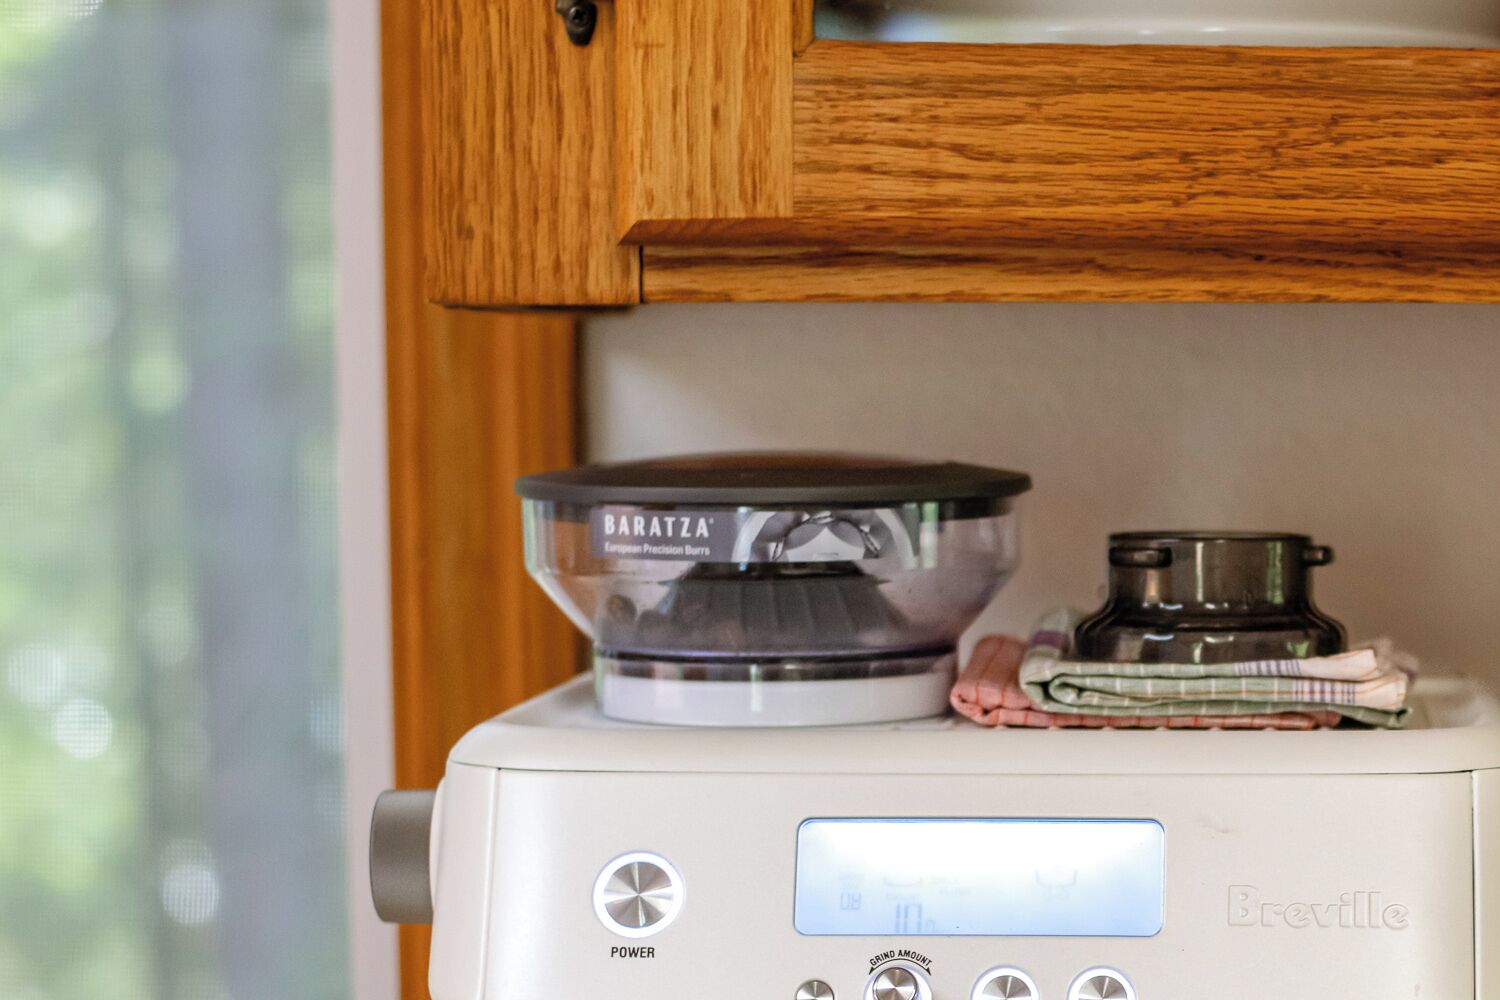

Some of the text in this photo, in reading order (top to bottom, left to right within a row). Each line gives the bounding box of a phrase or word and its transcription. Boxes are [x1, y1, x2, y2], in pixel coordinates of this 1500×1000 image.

[604, 541, 711, 556] European Precision Burrs
[1227, 884, 1410, 930] Breville
[610, 946, 655, 959] POWER
[870, 950, 932, 967] GRIND AMOUNT
